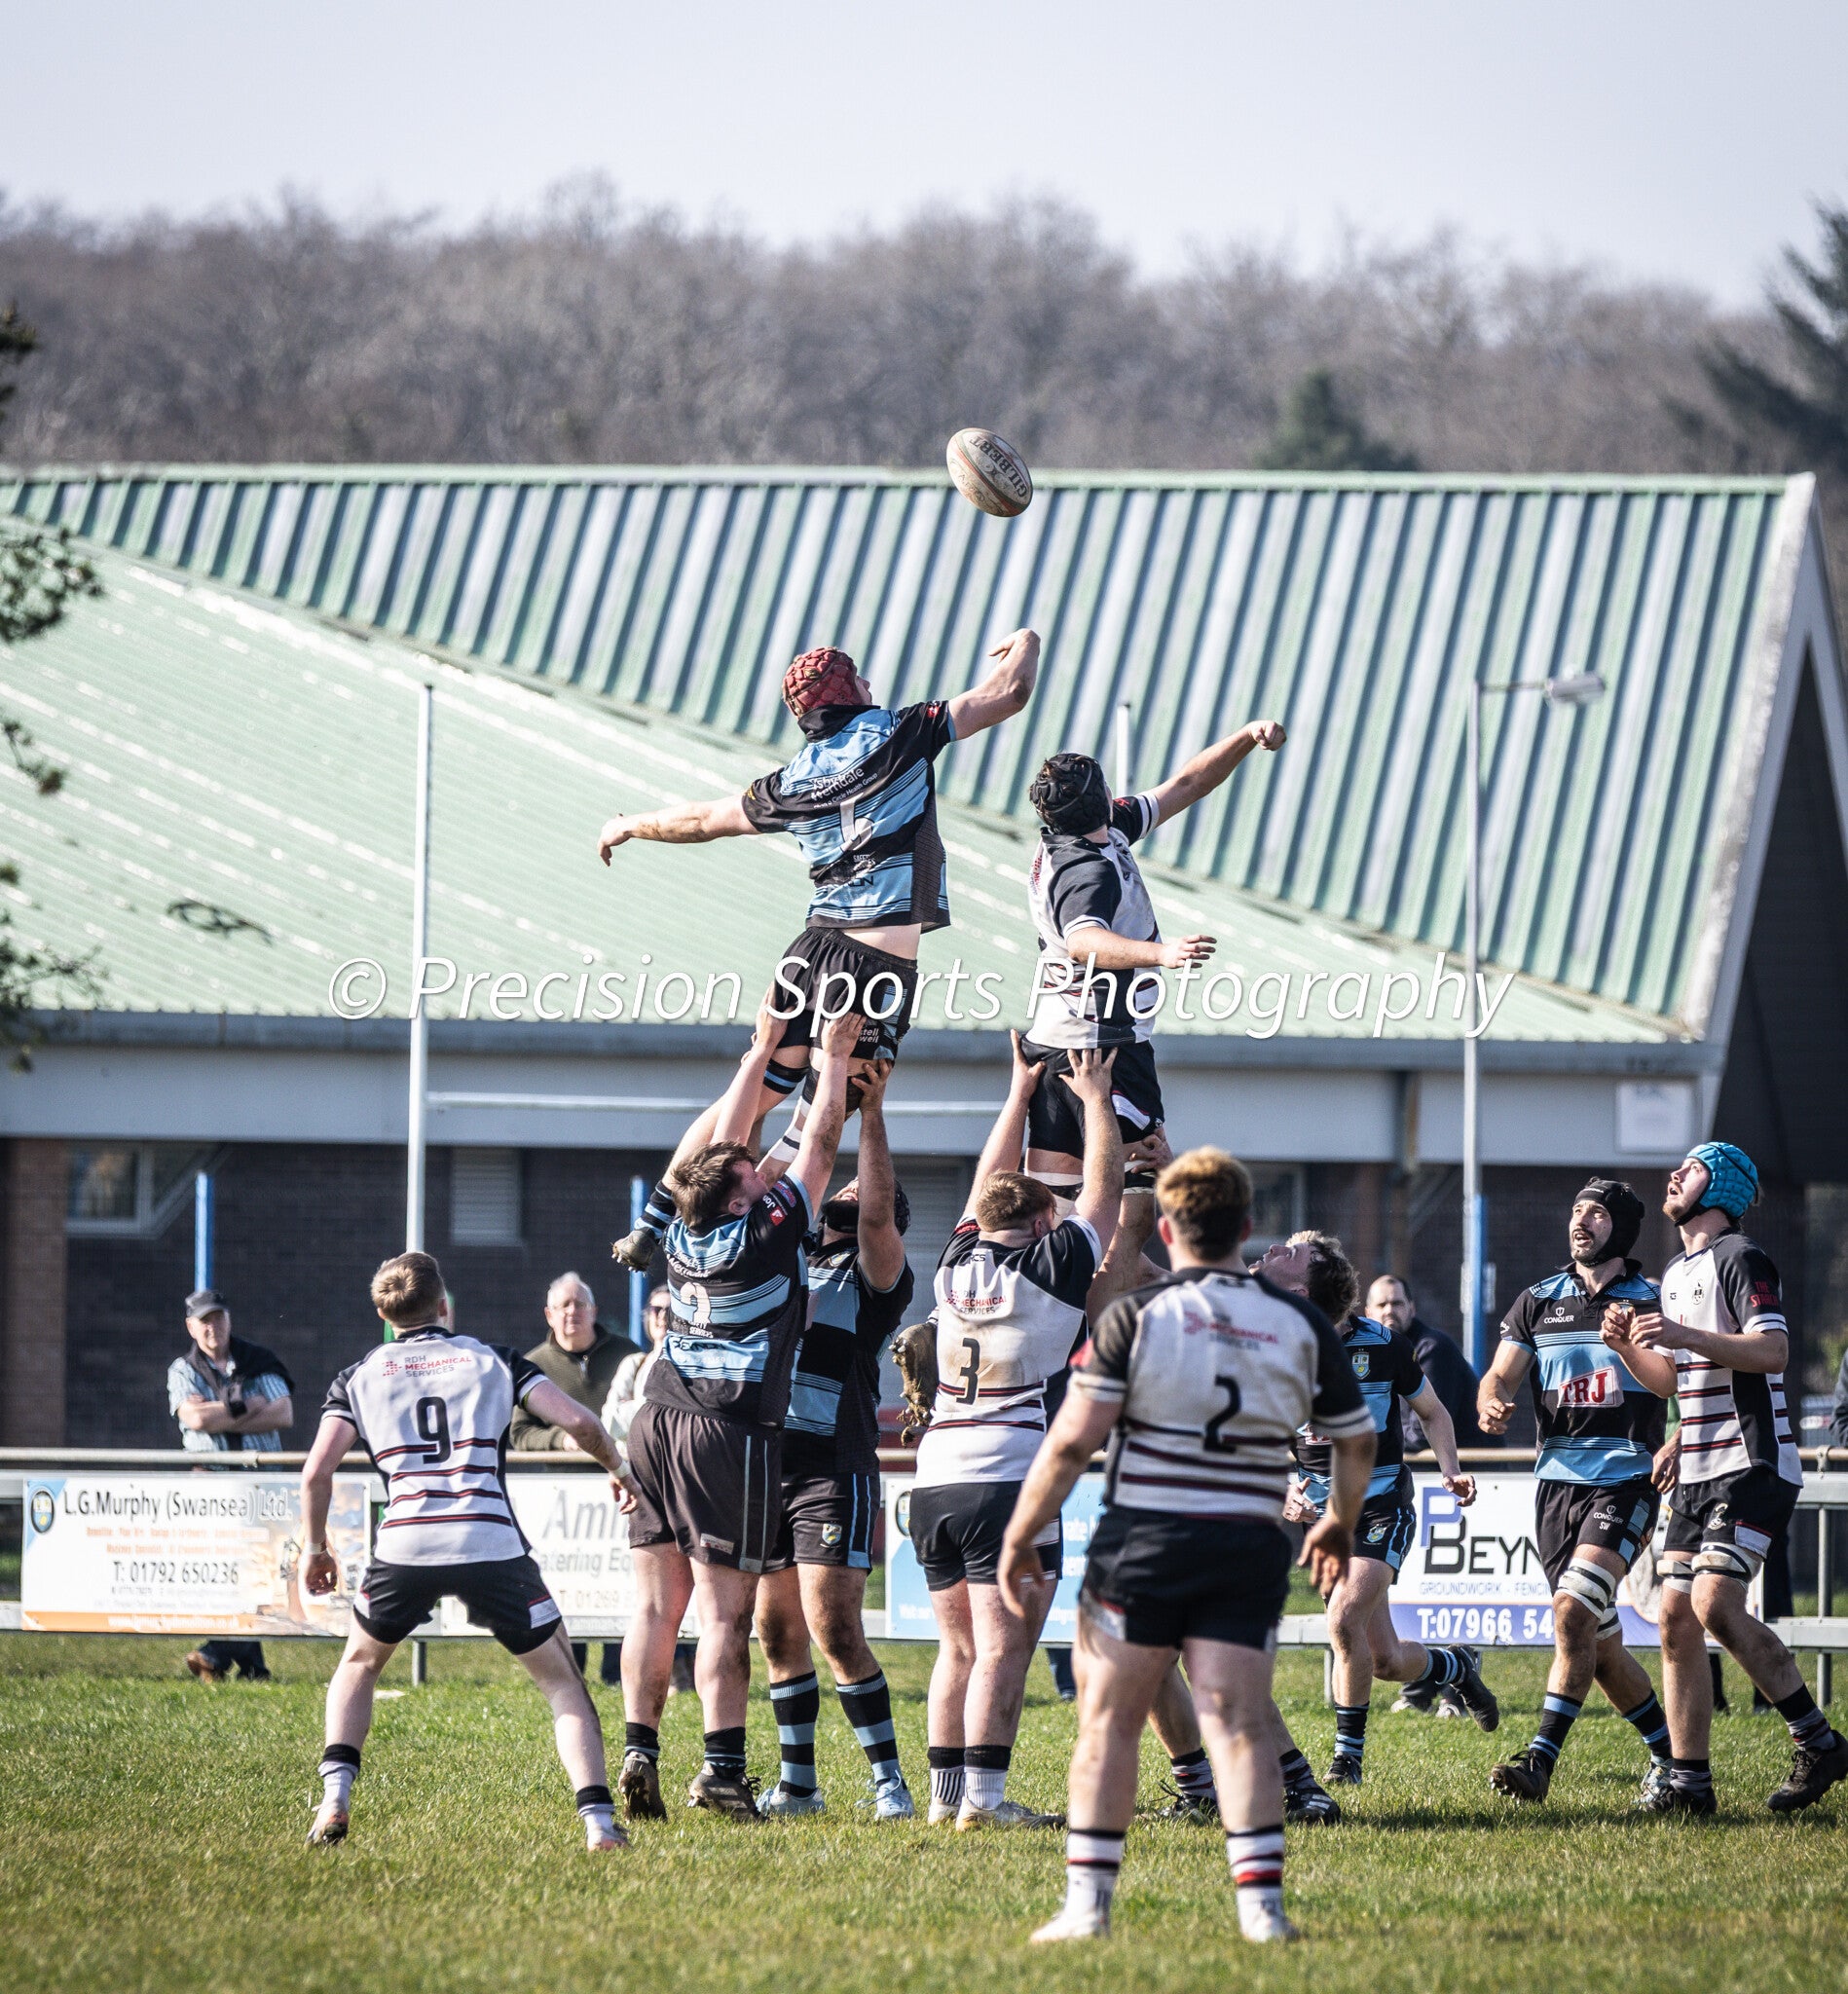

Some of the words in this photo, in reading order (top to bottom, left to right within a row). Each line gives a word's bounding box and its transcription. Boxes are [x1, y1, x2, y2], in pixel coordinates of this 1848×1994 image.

[970, 436, 1027, 498] GILBERT
[959, 1307, 996, 1315] SERVICES
[1543, 1314, 1574, 1324] CONQUER
[404, 1354, 426, 1363] RDH
[404, 1356, 472, 1371] MECHANICAL
[405, 1364, 455, 1378] SERVICES
[956, 1338, 980, 1405] 3
[1561, 1373, 1608, 1404] TRJ
[1203, 1375, 1241, 1454] 2
[416, 1397, 451, 1464] 9
[166, 1492, 255, 1523] (Swansea)
[1593, 1512, 1624, 1525] CONQUER
[1599, 1521, 1611, 1531] SW
[114, 1561, 125, 1582] T:
[129, 1561, 176, 1584] 01792
[181, 1562, 240, 1585] 650236
[532, 1549, 603, 1577] atering
[1420, 1582, 1501, 1596] GROUNDWORK
[1417, 1607, 1512, 1642] T:07966
